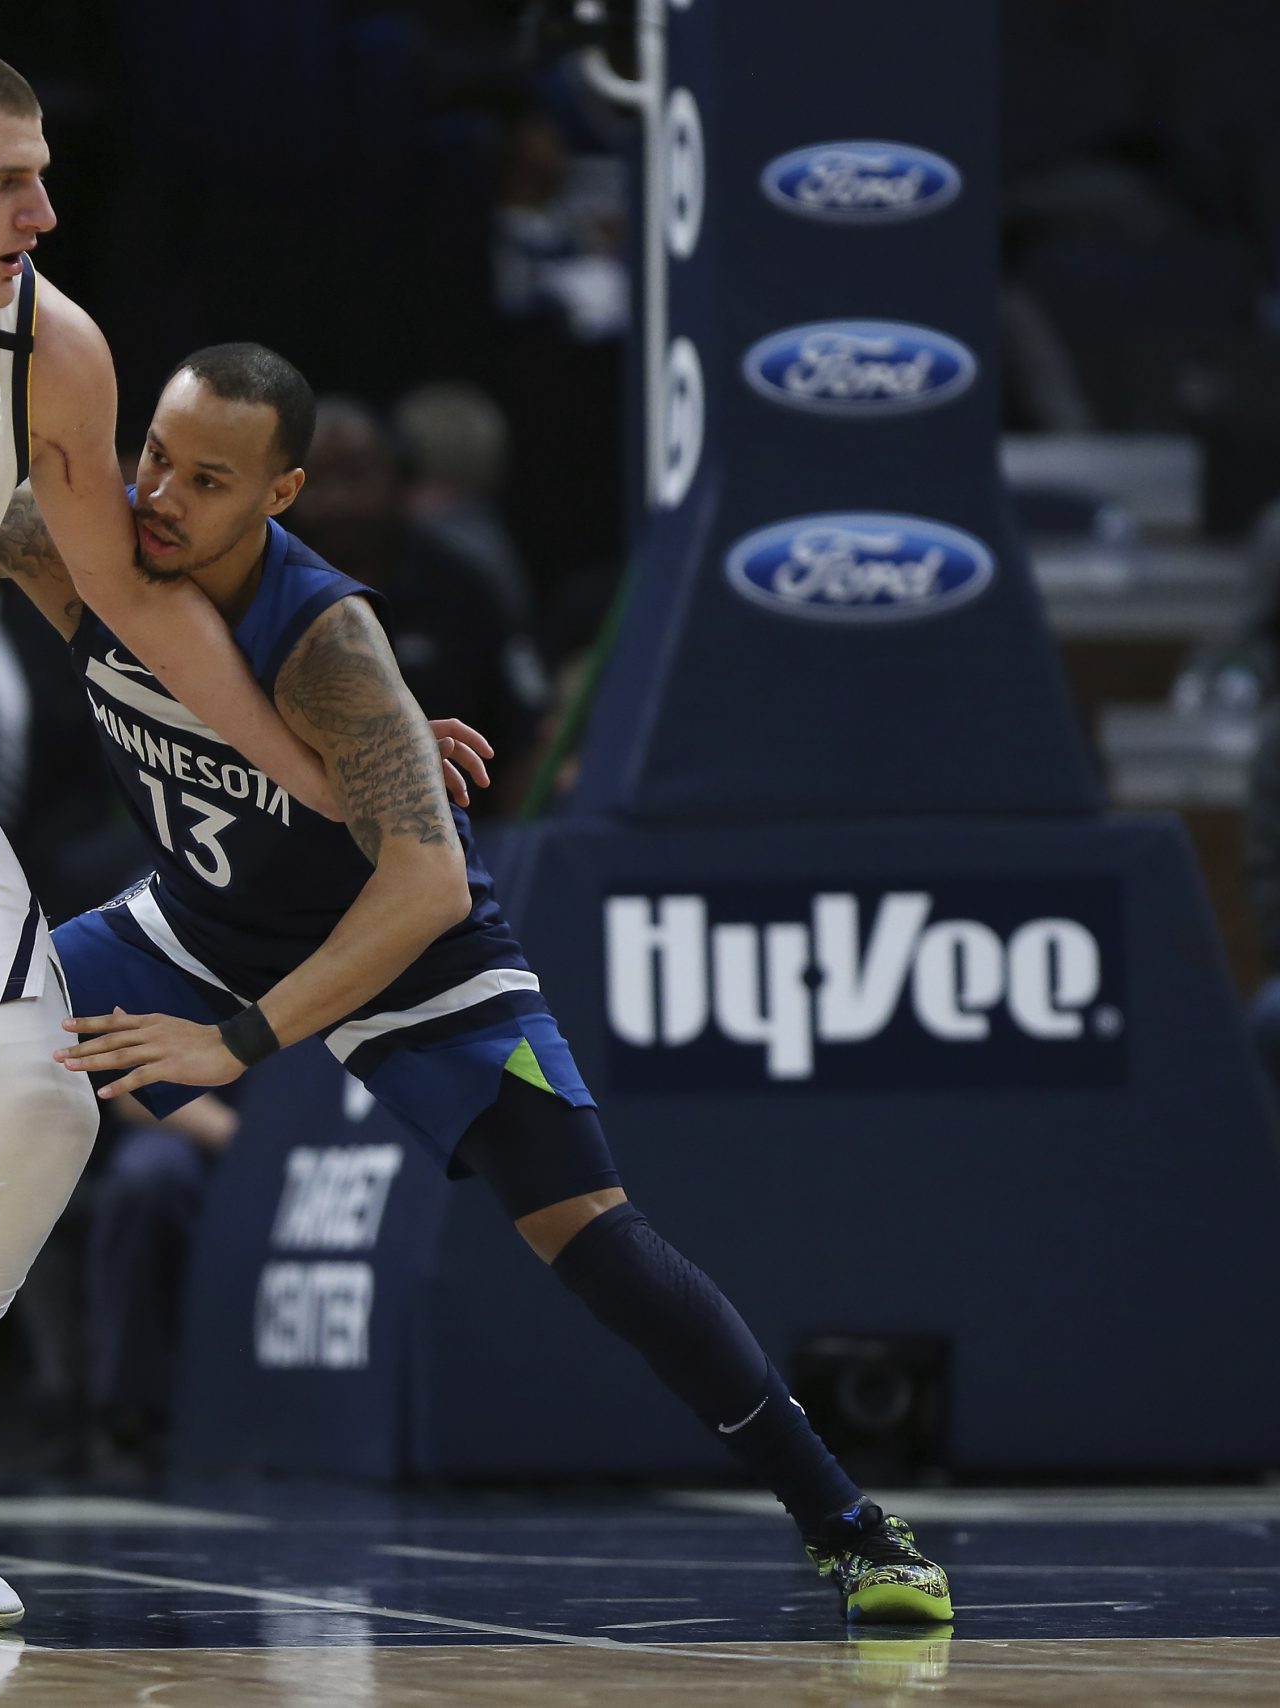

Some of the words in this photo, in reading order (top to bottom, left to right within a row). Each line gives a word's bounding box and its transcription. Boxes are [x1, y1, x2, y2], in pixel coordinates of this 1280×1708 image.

[797, 150, 924, 205] Ford
[784, 331, 935, 400] Ford
[773, 526, 947, 603] Ford
[86, 687, 290, 828] MINNESOTA
[138, 769, 237, 888] 13
